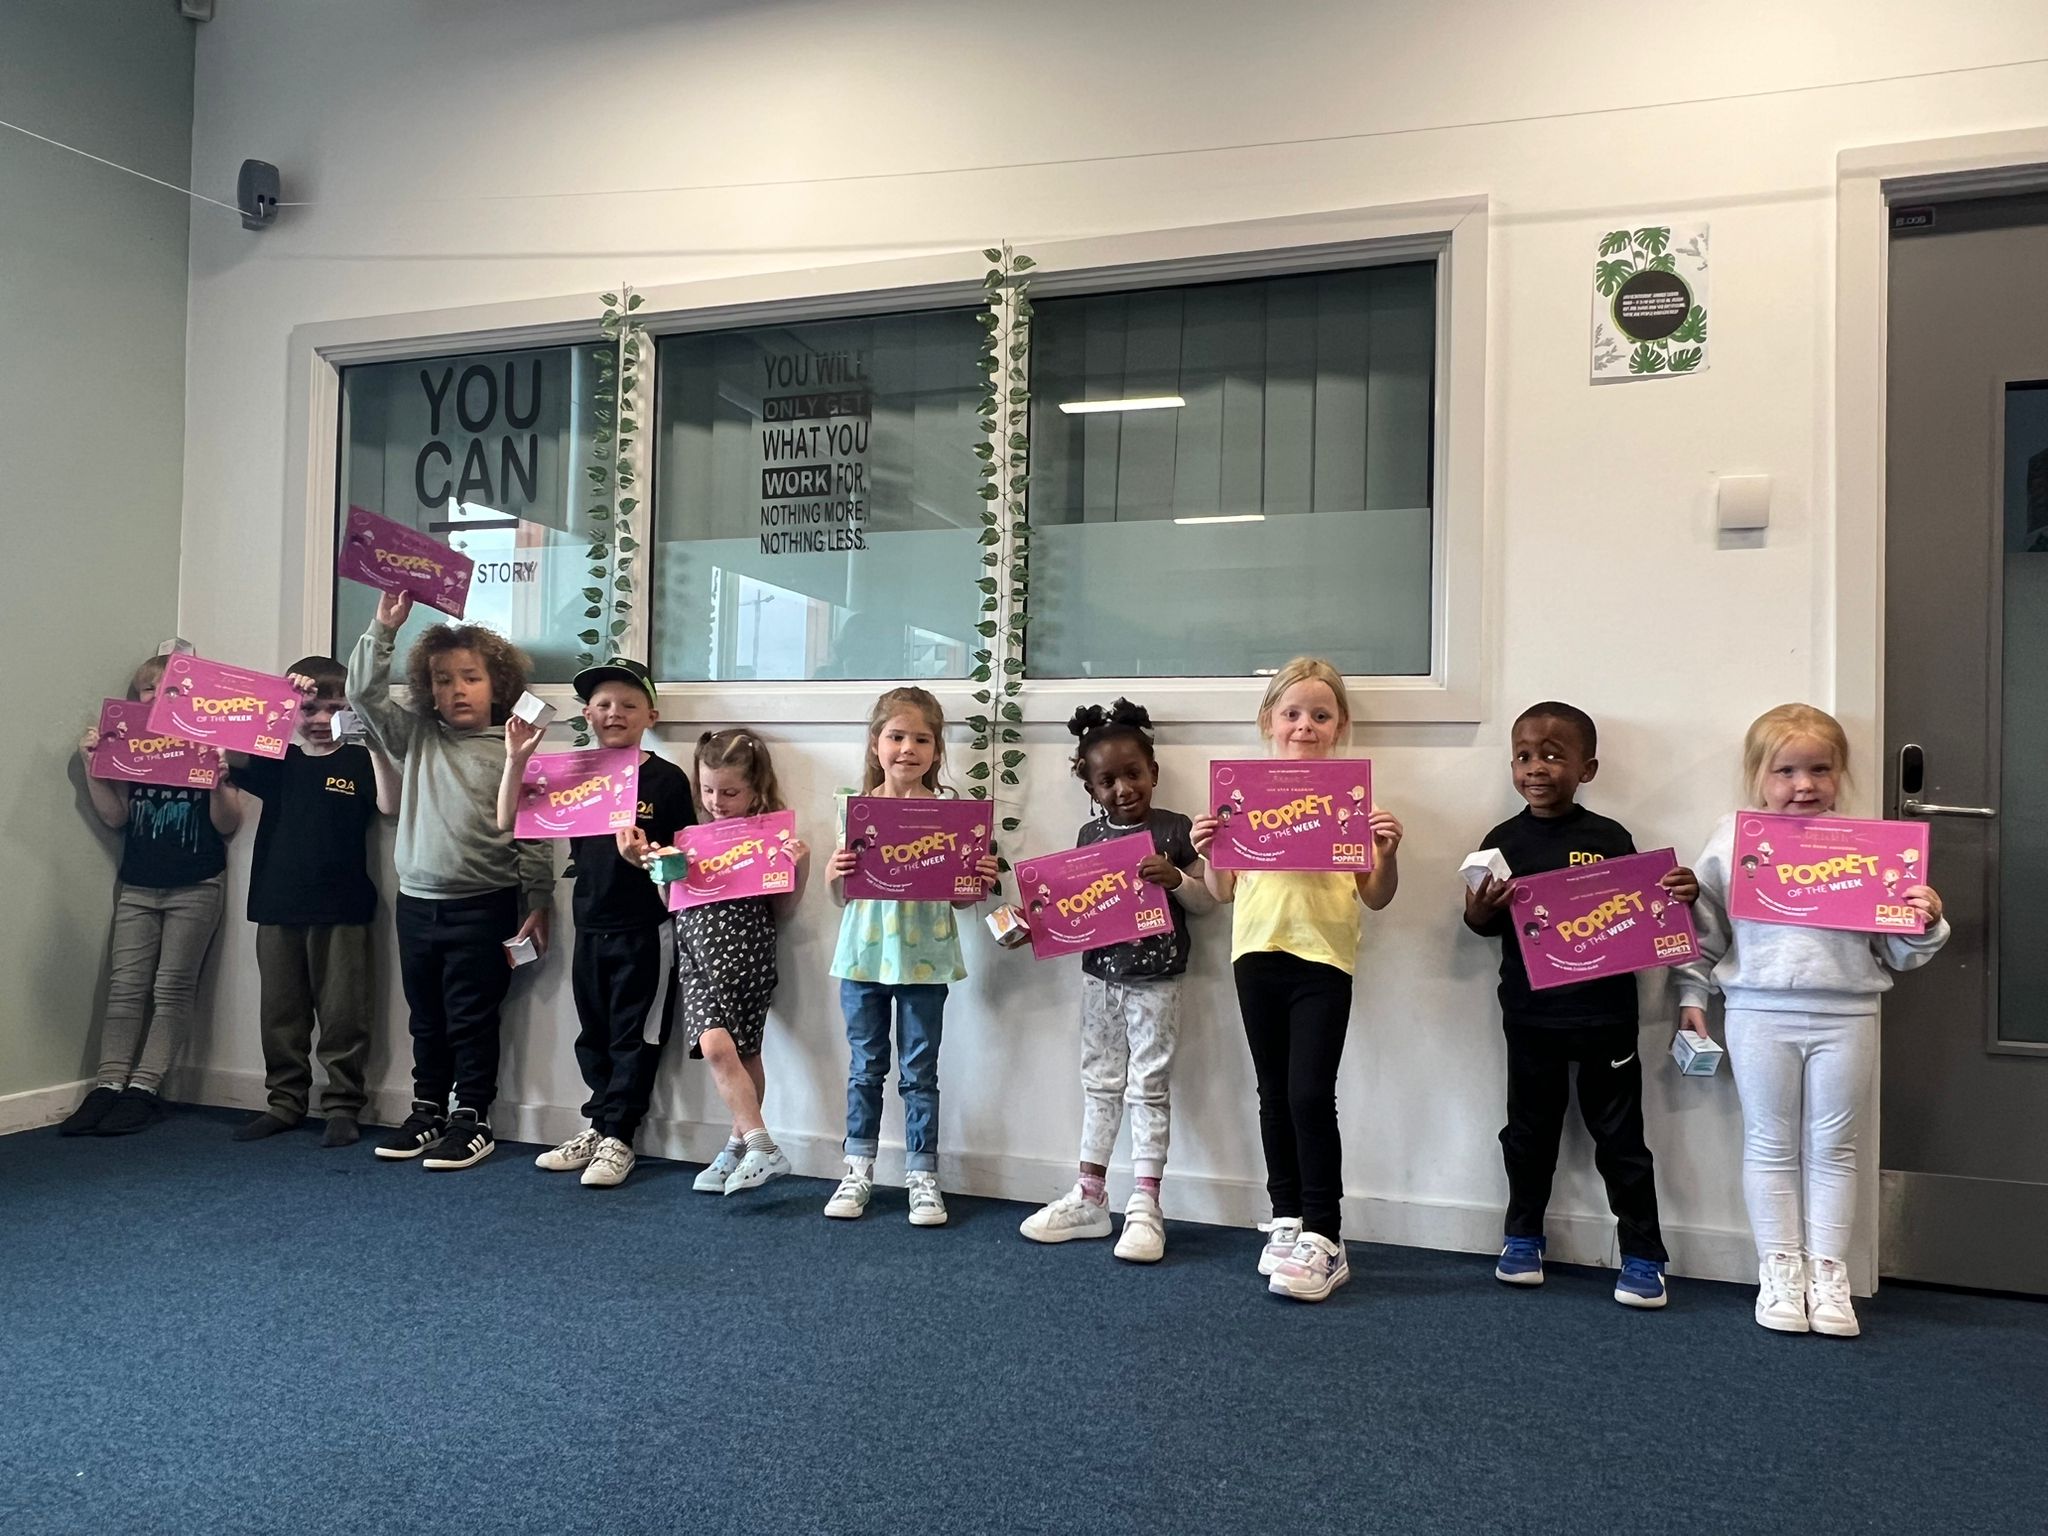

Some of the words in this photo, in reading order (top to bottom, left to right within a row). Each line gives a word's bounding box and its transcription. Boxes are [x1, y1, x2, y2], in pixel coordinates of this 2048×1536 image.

[764, 353, 808, 389] YOU
[816, 350, 868, 384] WILL
[420, 359, 541, 436] YOU
[764, 397, 817, 419] ONLY
[826, 394, 865, 415] GET
[763, 426, 820, 461] WHAT
[826, 421, 868, 457] YOU
[415, 433, 538, 508] CAN
[765, 469, 829, 496] WORK
[760, 503, 821, 526] NOTHING
[825, 500, 867, 524] MORE,
[760, 530, 824, 554] NOTHING
[828, 528, 867, 551] LESS.
[375, 549, 443, 577] POPPET
[477, 561, 535, 584] STORY
[192, 697, 269, 715] POPPET
[128, 736, 195, 753] POPPE
[326, 777, 355, 791] PQA
[548, 774, 612, 807] POPPET
[637, 800, 653, 814] QA
[1248, 795, 1333, 831] POPPET
[1258, 832, 1270, 844] OF
[1274, 828, 1291, 839] THE
[1293, 820, 1321, 834] WEEK
[698, 839, 765, 875] POPPET
[880, 832, 958, 863] POPPET
[890, 868, 900, 876] OF
[904, 861, 920, 872] THE
[921, 854, 945, 867] WEEK
[1776, 854, 1879, 885] POPPET
[1056, 870, 1128, 918] POPPET
[1787, 886, 1803, 898] OF
[1805, 885, 1828, 894] THE
[1829, 878, 1863, 892] WEEK
[1071, 916, 1081, 927] OF
[1083, 907, 1098, 920] THE
[1098, 894, 1121, 912] WEEK
[1556, 891, 1645, 943] POPPET
[1574, 941, 1587, 953] OF
[1590, 932, 1608, 946] THE
[1607, 917, 1637, 937] WEEK
